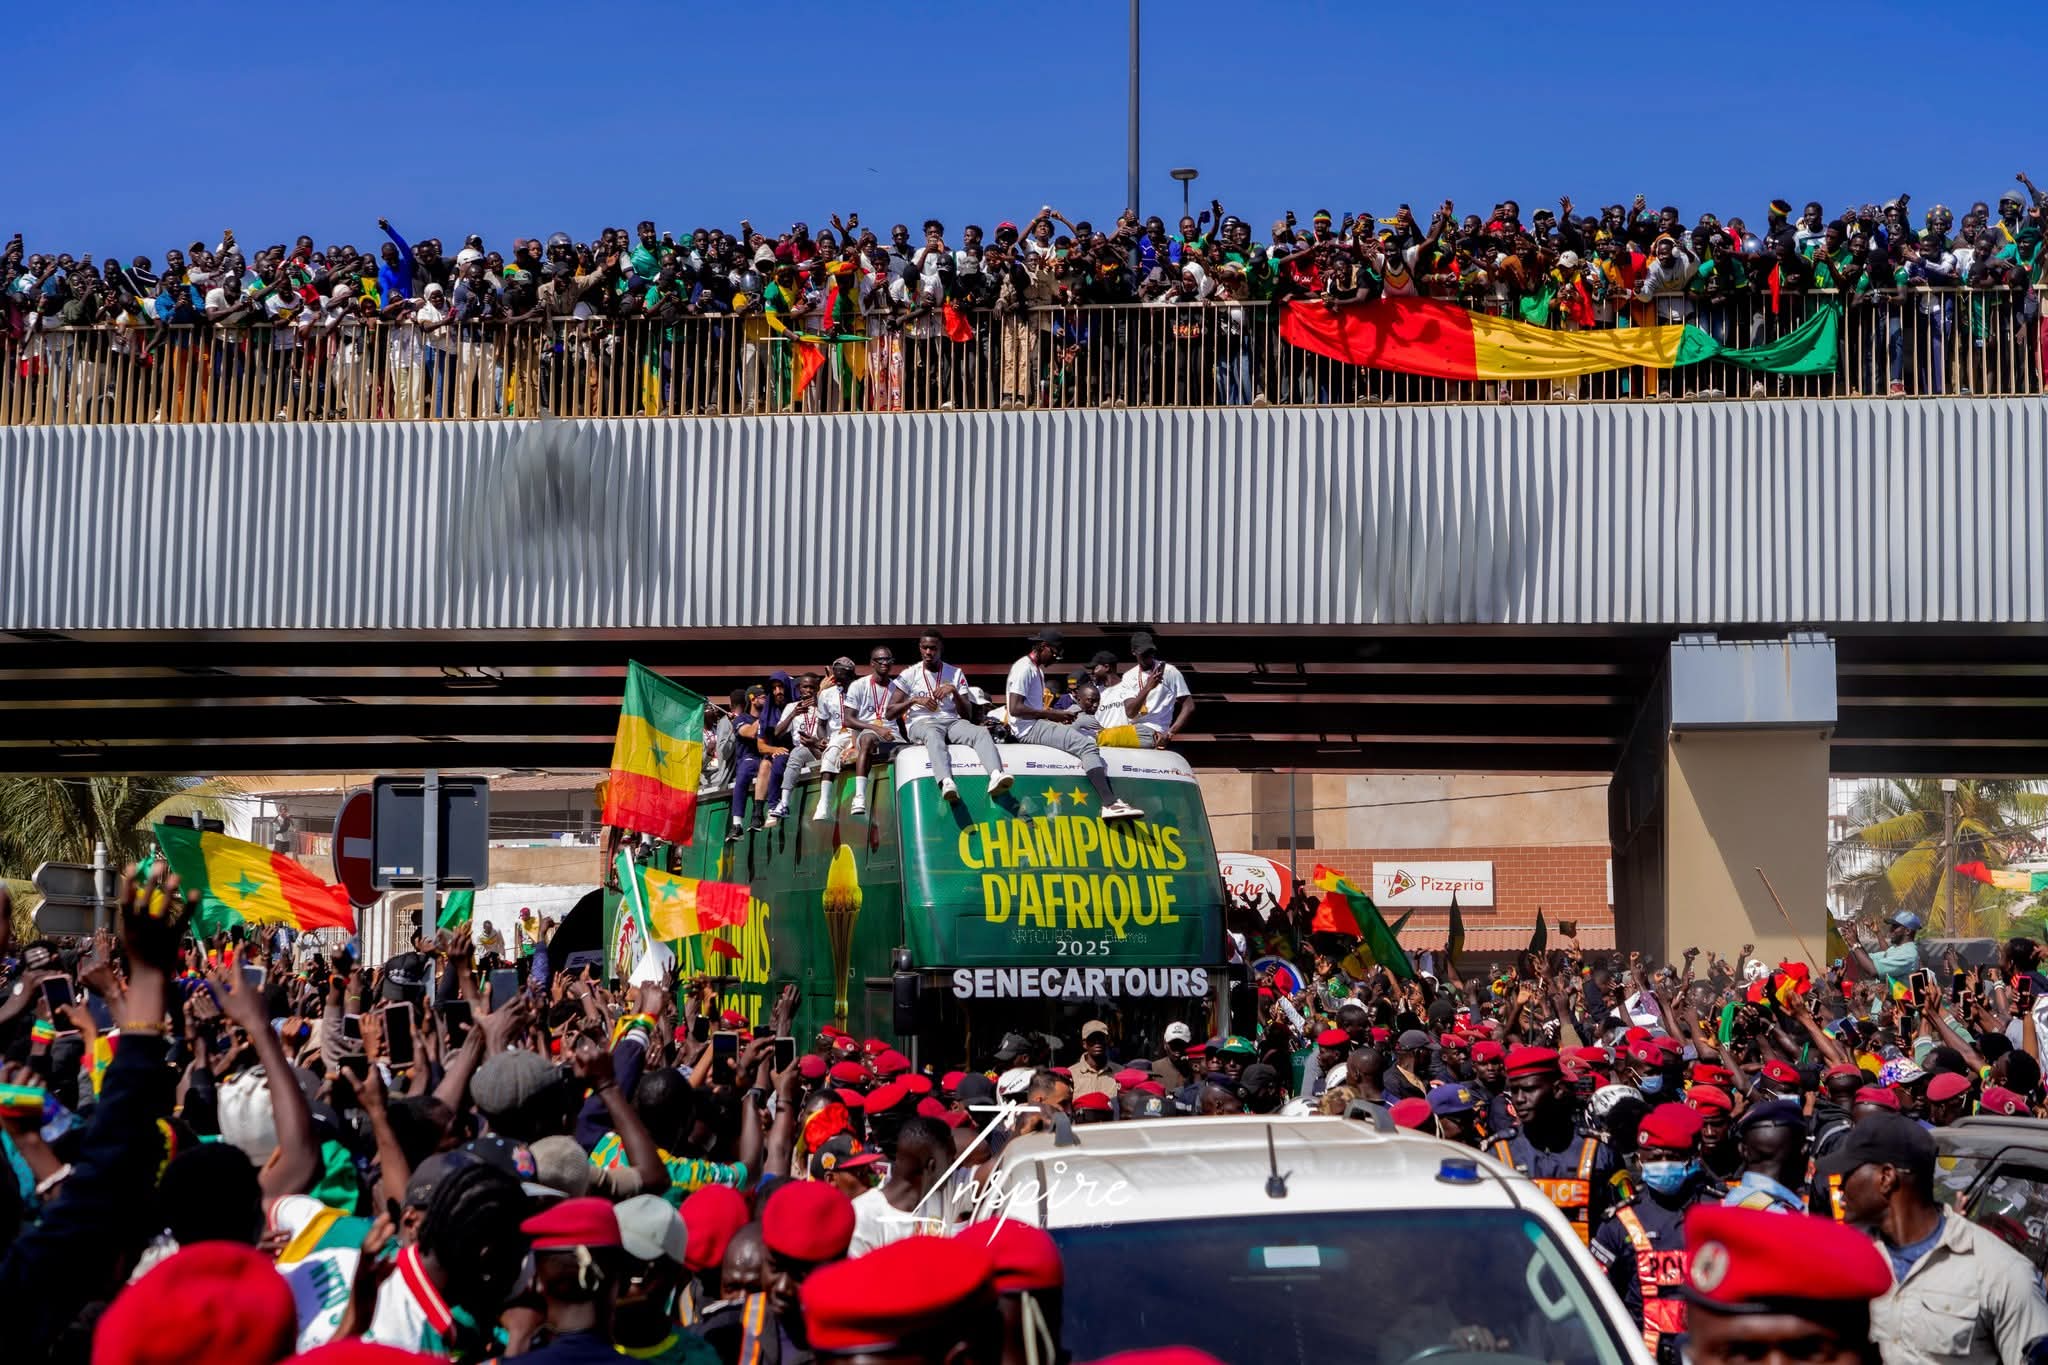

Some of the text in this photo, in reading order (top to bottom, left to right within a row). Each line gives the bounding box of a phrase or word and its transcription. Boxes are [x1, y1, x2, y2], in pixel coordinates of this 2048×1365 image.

[958, 815, 1187, 871] CHAMPIONS
[1421, 875, 1484, 891] Pizzeria
[982, 873, 1180, 940] D'AFRIQUE
[1056, 940, 1111, 956] 2025
[952, 967, 1209, 999] SENECARTOURS
